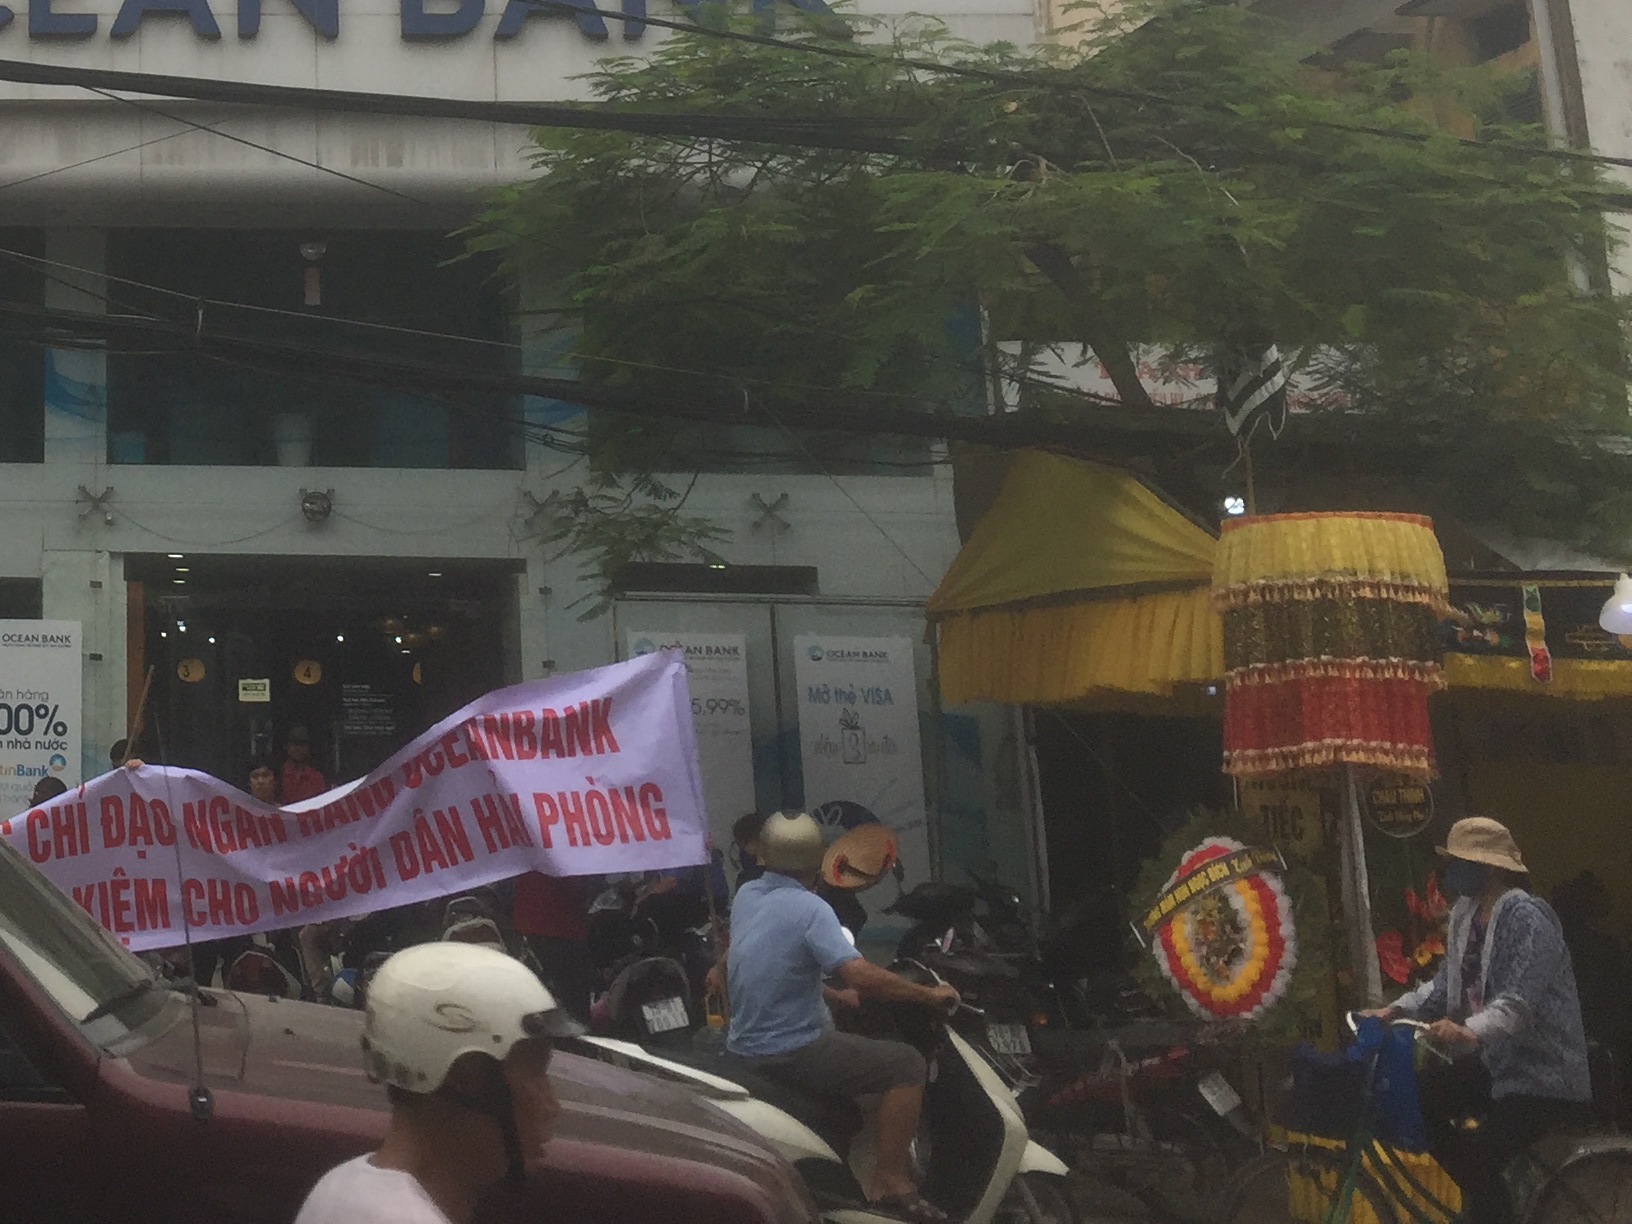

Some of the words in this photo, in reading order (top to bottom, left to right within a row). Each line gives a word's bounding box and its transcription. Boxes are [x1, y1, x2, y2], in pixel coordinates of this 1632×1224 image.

[1, 633, 39, 643] OCEAN
[41, 633, 72, 644] BANK
[16, 687, 50, 703] hàng
[859, 686, 895, 706] VISA
[6, 738, 32, 751] nhà
[34, 737, 69, 751] nước
[26, 782, 90, 864] CHỈ
[100, 792, 178, 859] ĐẠO
[183, 877, 260, 927] CHO
[269, 842, 388, 917] NGƯỜI
[389, 804, 475, 882] DÂN
[532, 775, 673, 850] PHÒNG
